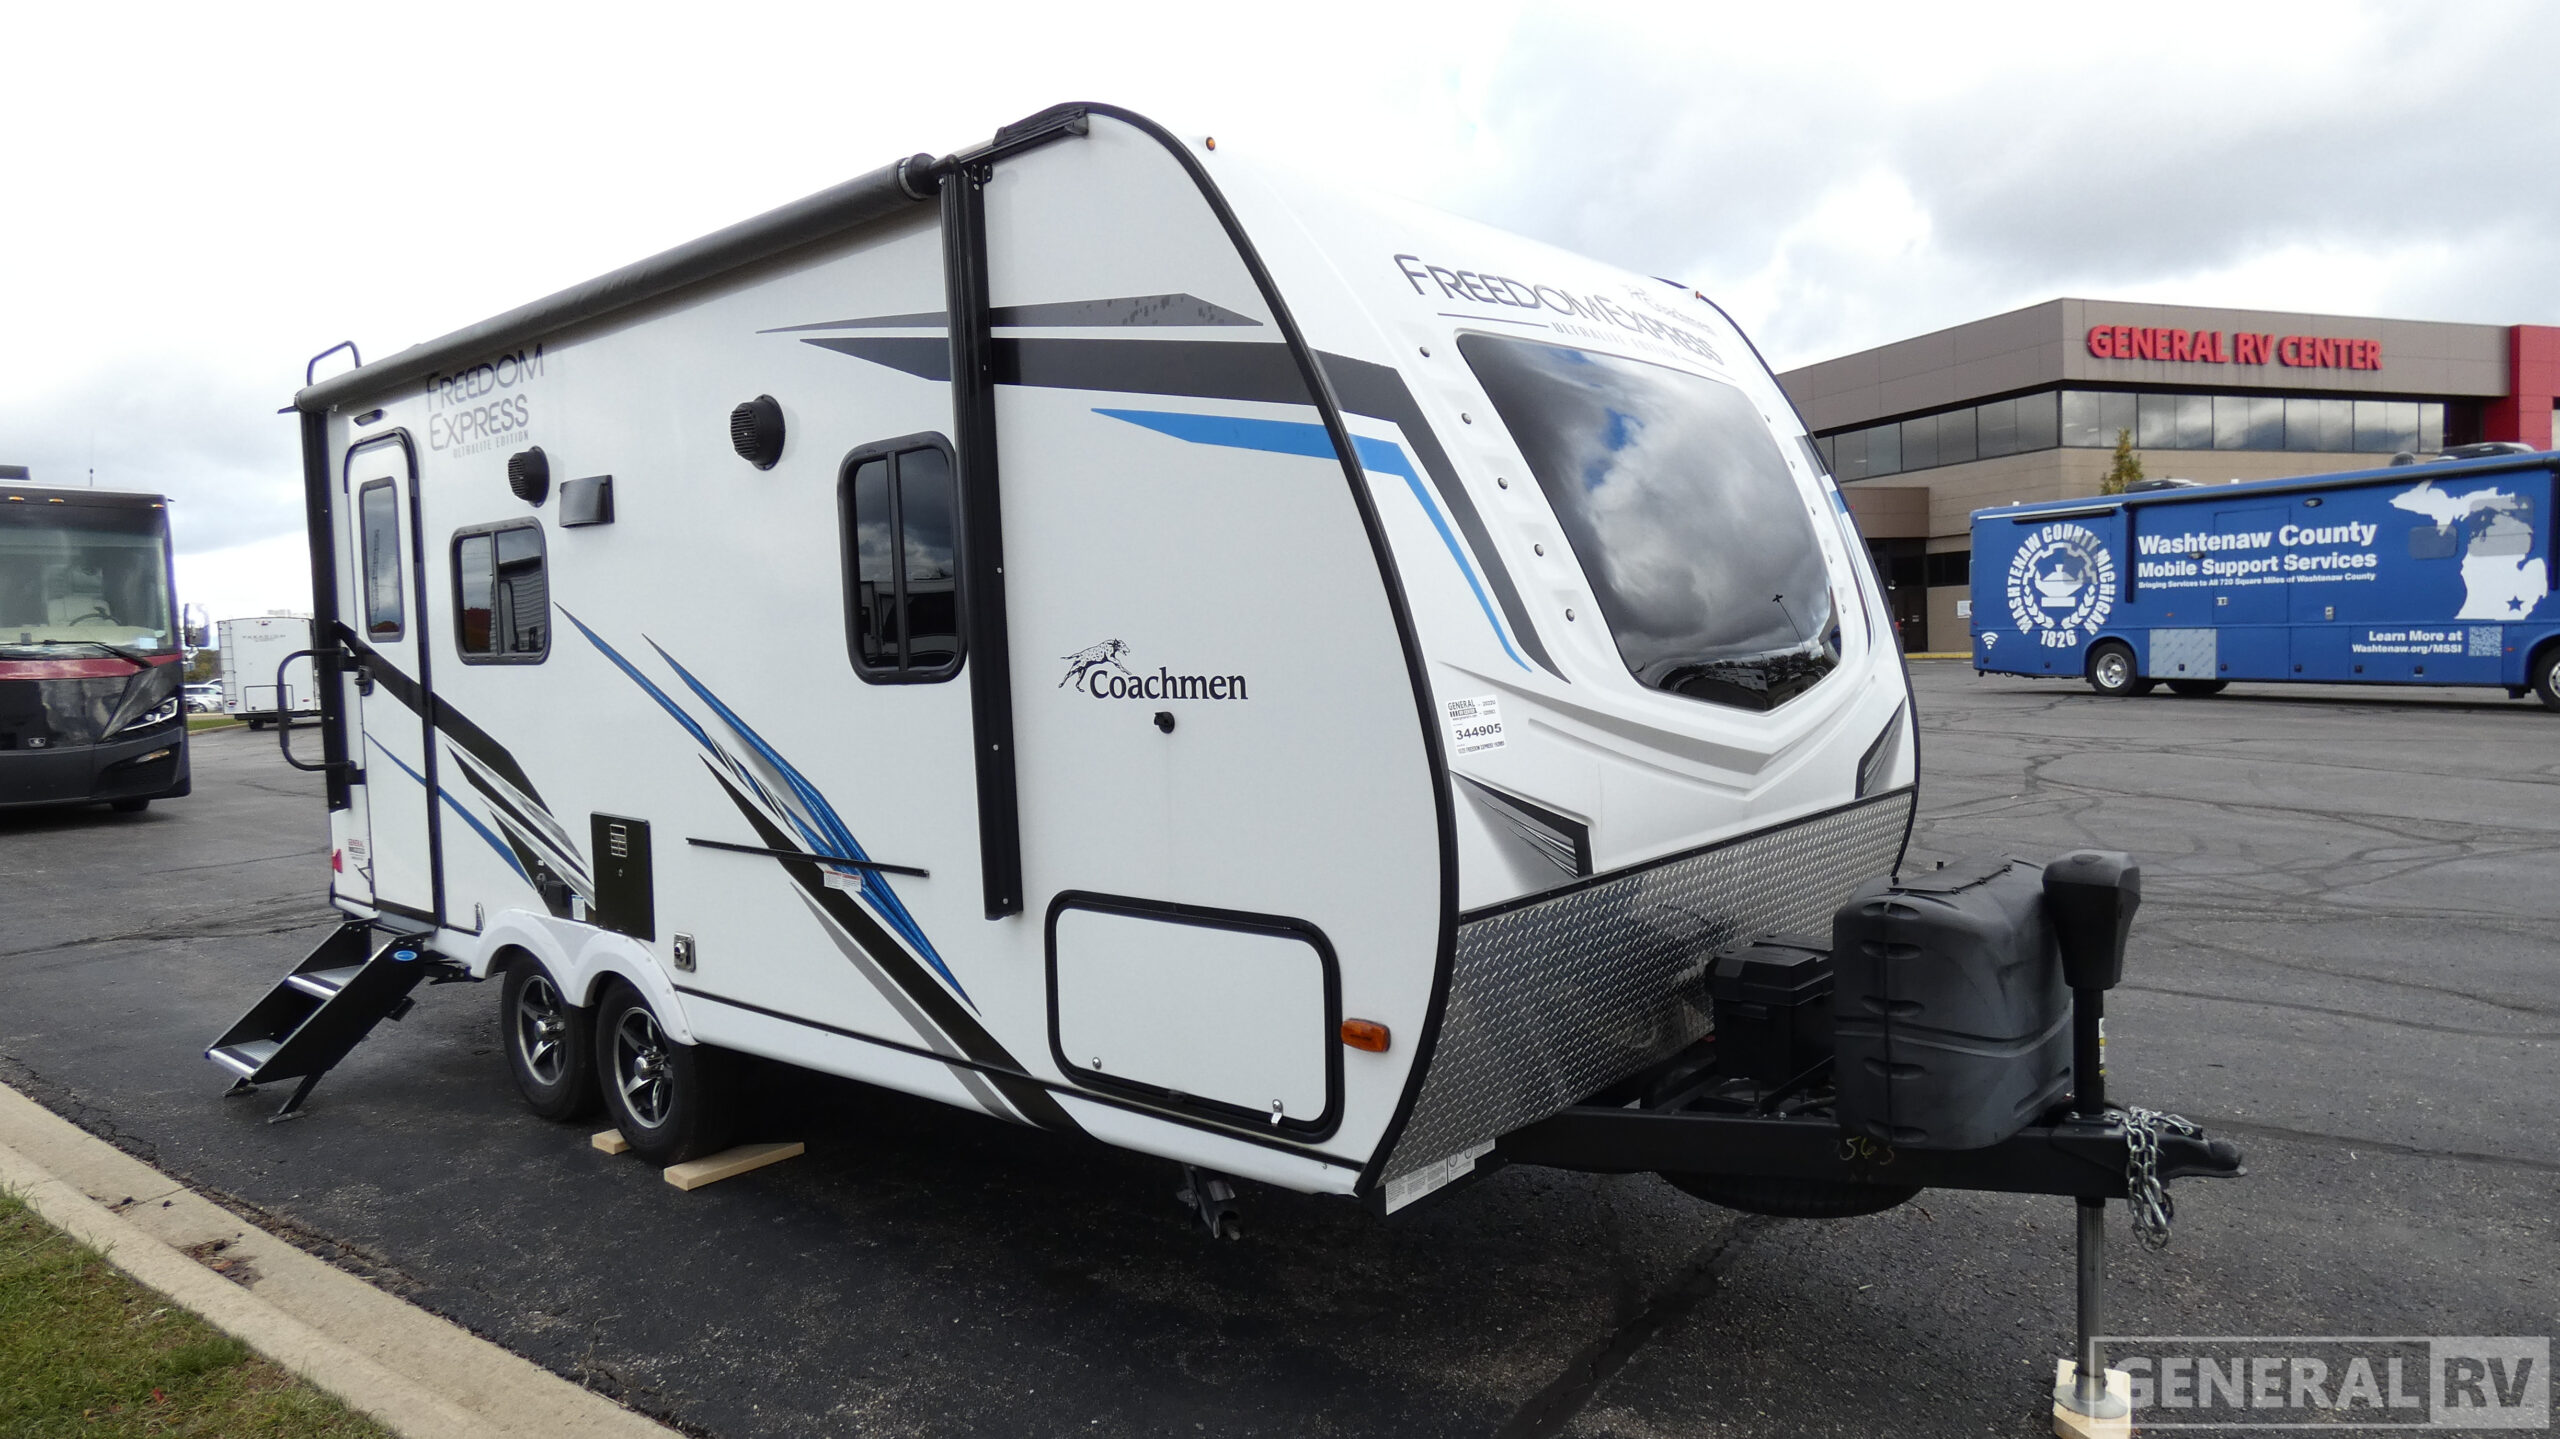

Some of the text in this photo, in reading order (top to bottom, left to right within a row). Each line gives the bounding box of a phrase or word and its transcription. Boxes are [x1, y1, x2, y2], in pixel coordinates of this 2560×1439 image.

[1394, 254, 1600, 322] FREEDOM
[2087, 324, 2383, 371] GENERAL RV CENTER
[427, 343, 544, 412] FREEDOM
[429, 393, 529, 451] EXPRESS
[2138, 520, 2378, 555] Washtenaw County
[2007, 523, 2116, 636] WASHTENAW COUNTY MICHIGAN
[2138, 552, 2377, 578] Mobile Support Services
[2138, 580, 2167, 590] Bringing
[2167, 580, 2198, 588] Services
[2235, 577, 2262, 587] Square
[2263, 576, 2285, 584] Miles
[2286, 575, 2295, 583] of
[2296, 574, 2343, 583] Washtenaw
[2344, 572, 2376, 581] County
[2040, 629, 2077, 648] 1826
[2368, 630, 2463, 642] Learn More at
[1090, 666, 1249, 700] Coachmen
[1448, 700, 1476, 711] GENERAL
[1456, 723, 1502, 740] 344905
